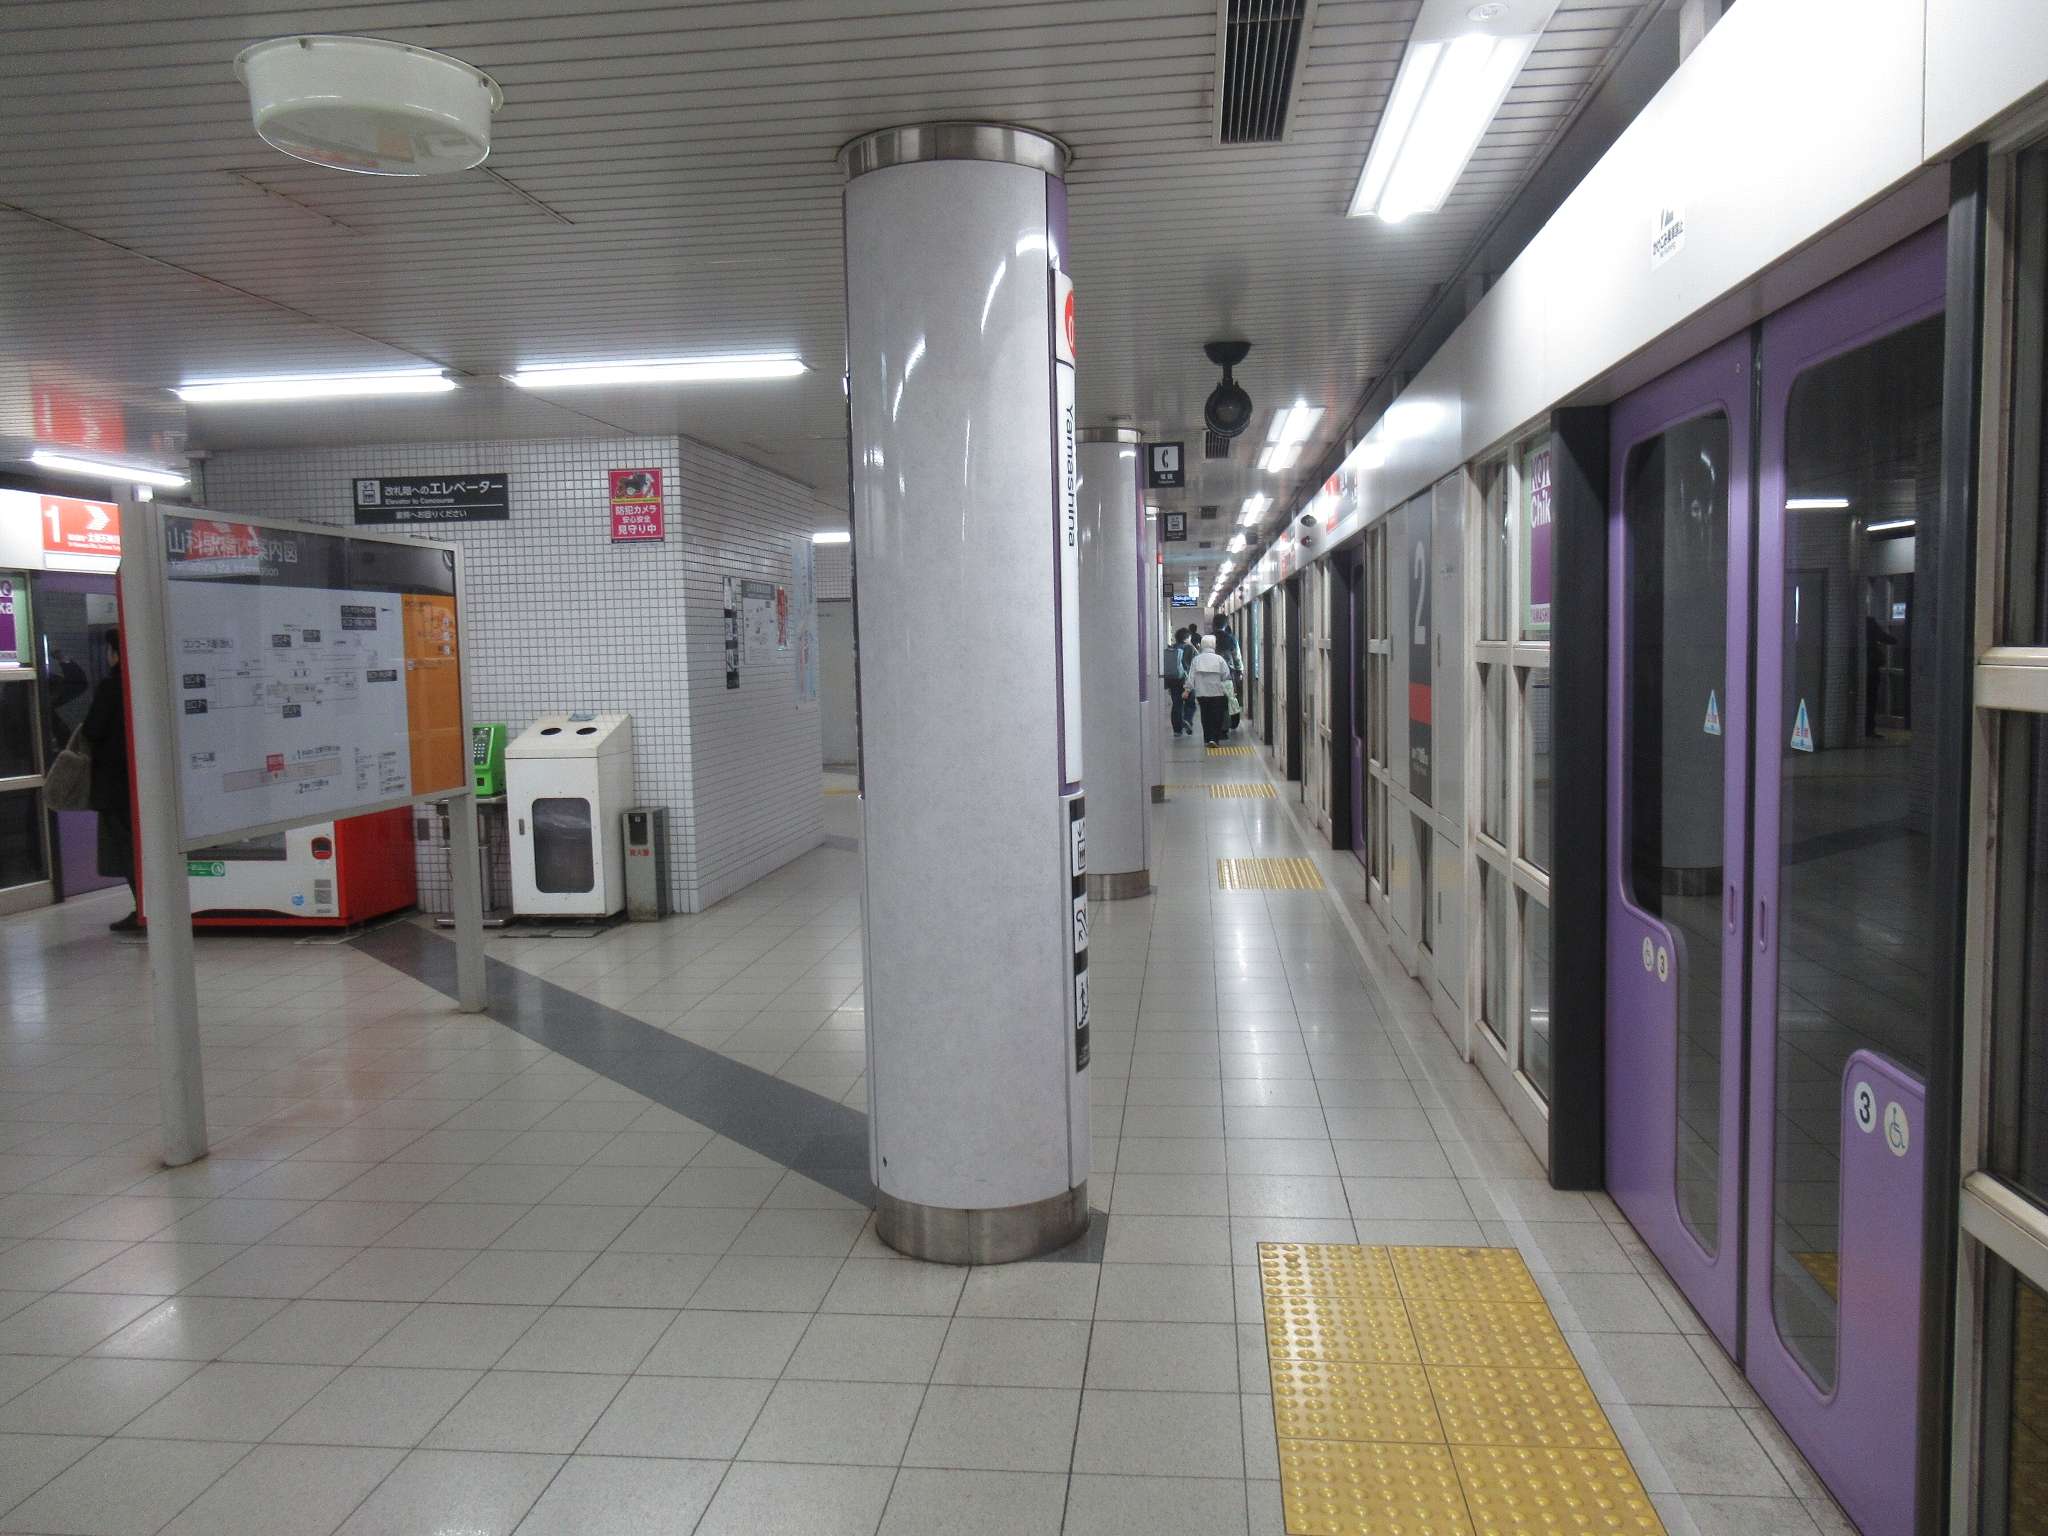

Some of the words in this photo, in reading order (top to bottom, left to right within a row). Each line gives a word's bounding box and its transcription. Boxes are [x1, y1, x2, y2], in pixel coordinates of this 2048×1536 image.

[384, 480, 503, 497] 改札階へのエレベーター
[1065, 403, 1077, 548] Yamashina
[43, 505, 61, 543] 1
[615, 505, 657, 516] 防犯カメラ
[617, 524, 657, 535] 見守り中
[1413, 540, 1426, 645] 2
[1859, 1091, 1872, 1124] 3
